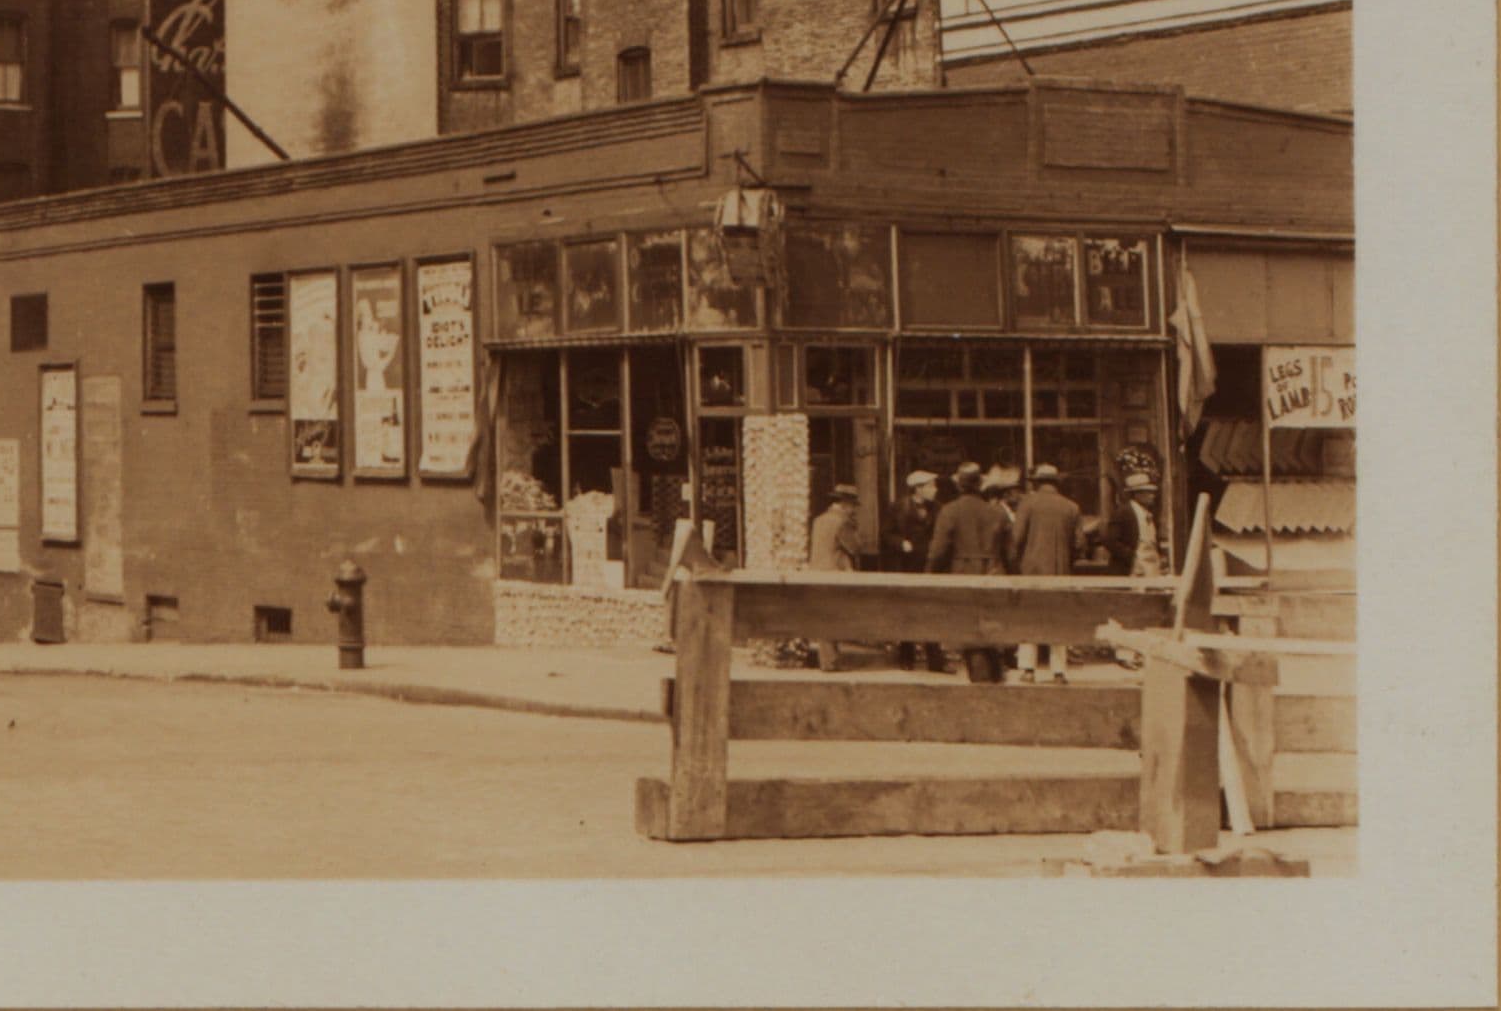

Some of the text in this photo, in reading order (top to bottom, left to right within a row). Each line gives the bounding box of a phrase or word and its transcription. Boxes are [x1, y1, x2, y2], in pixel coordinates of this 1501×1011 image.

[1268, 359, 1303, 384] LEGS
[1309, 355, 1333, 418] 15
[1266, 387, 1310, 421] LAMB
